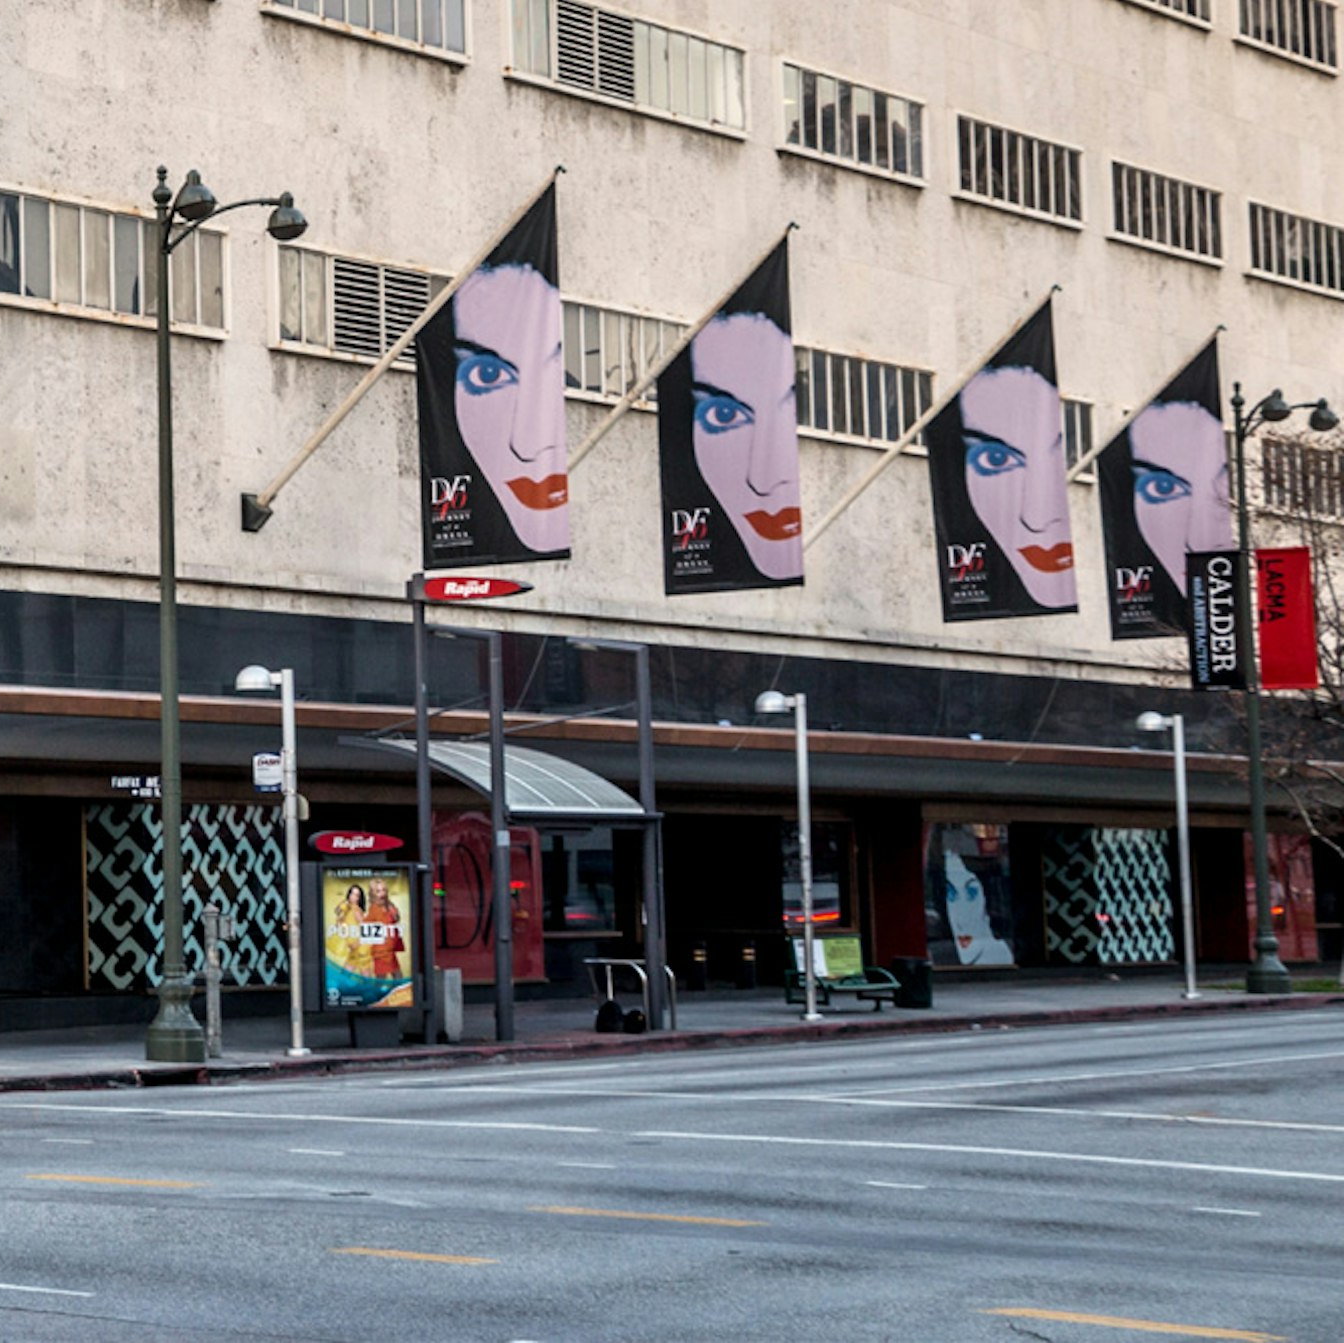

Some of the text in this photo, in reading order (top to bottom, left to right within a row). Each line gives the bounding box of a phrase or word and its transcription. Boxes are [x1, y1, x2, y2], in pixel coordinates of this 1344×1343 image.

[444, 581, 490, 598] Rapid
[1265, 559, 1286, 622] LACMA
[1207, 557, 1237, 673] CALDER
[333, 836, 375, 850] Rapid
